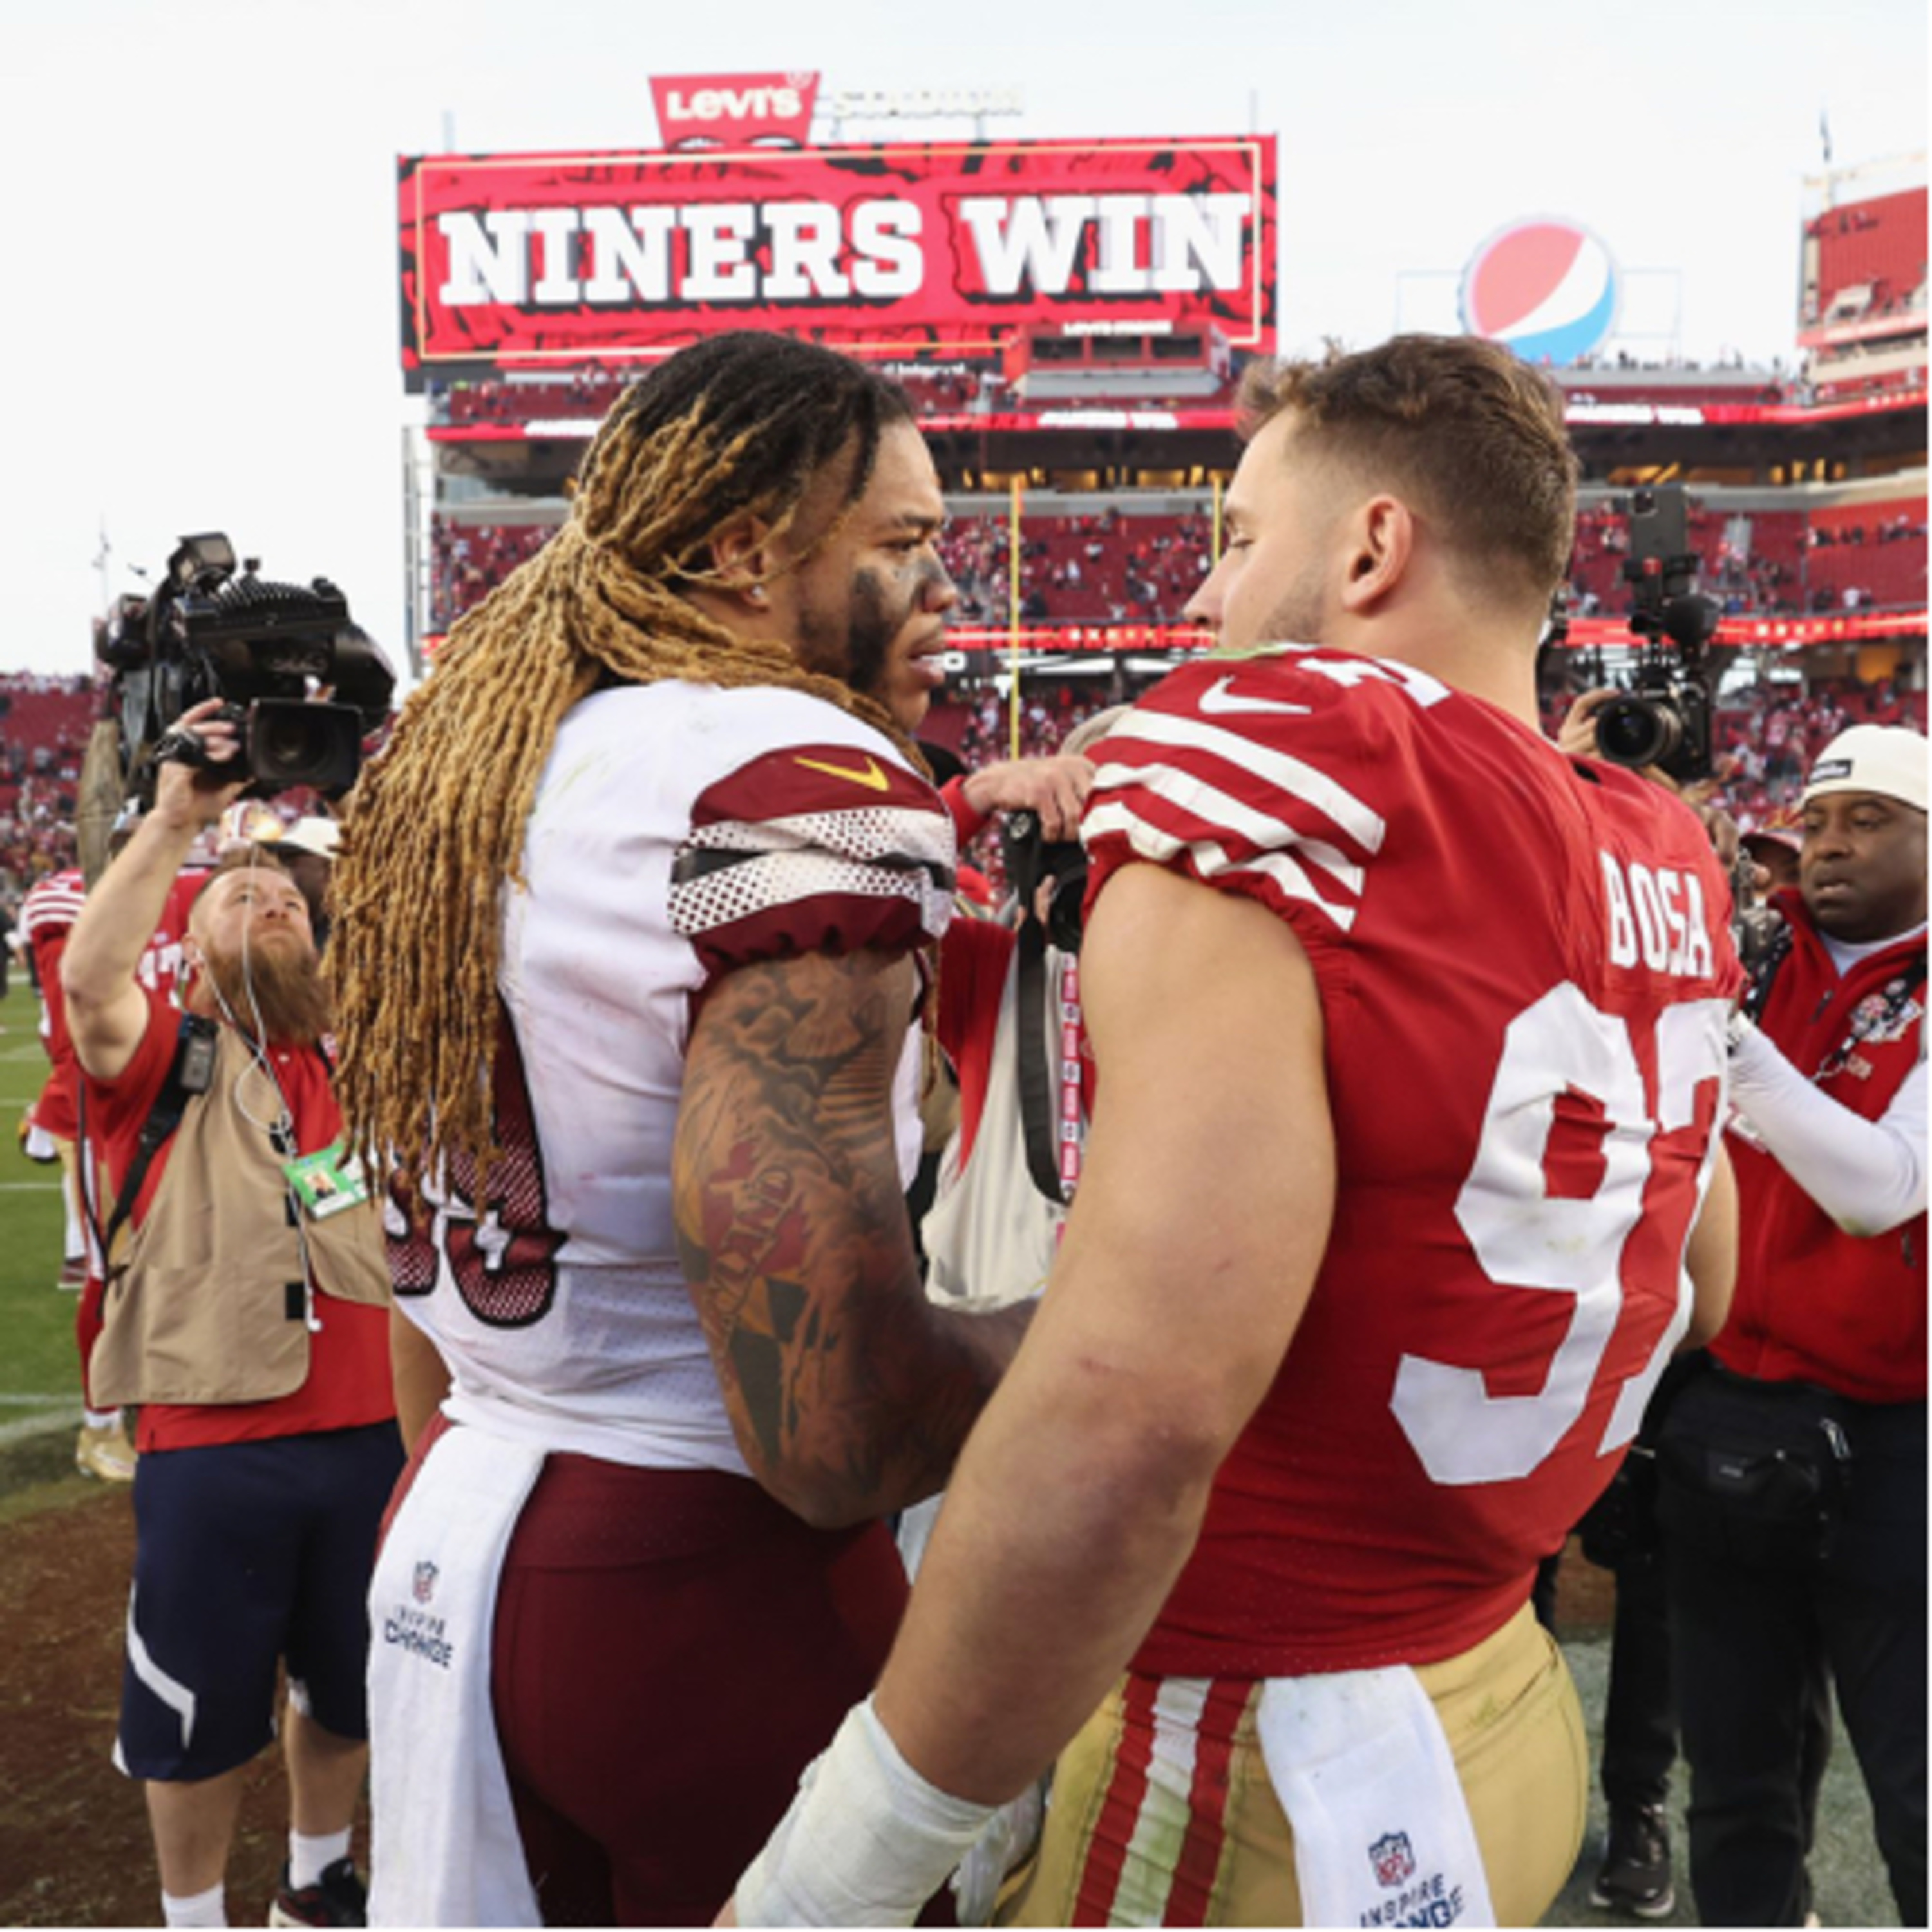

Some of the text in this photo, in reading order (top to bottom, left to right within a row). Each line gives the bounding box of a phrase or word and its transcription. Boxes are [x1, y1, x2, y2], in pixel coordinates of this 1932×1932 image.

[438, 193, 1253, 305] NINERS WIN
[1599, 848, 1714, 980] BOSA
[1389, 979, 1734, 1486] 97
